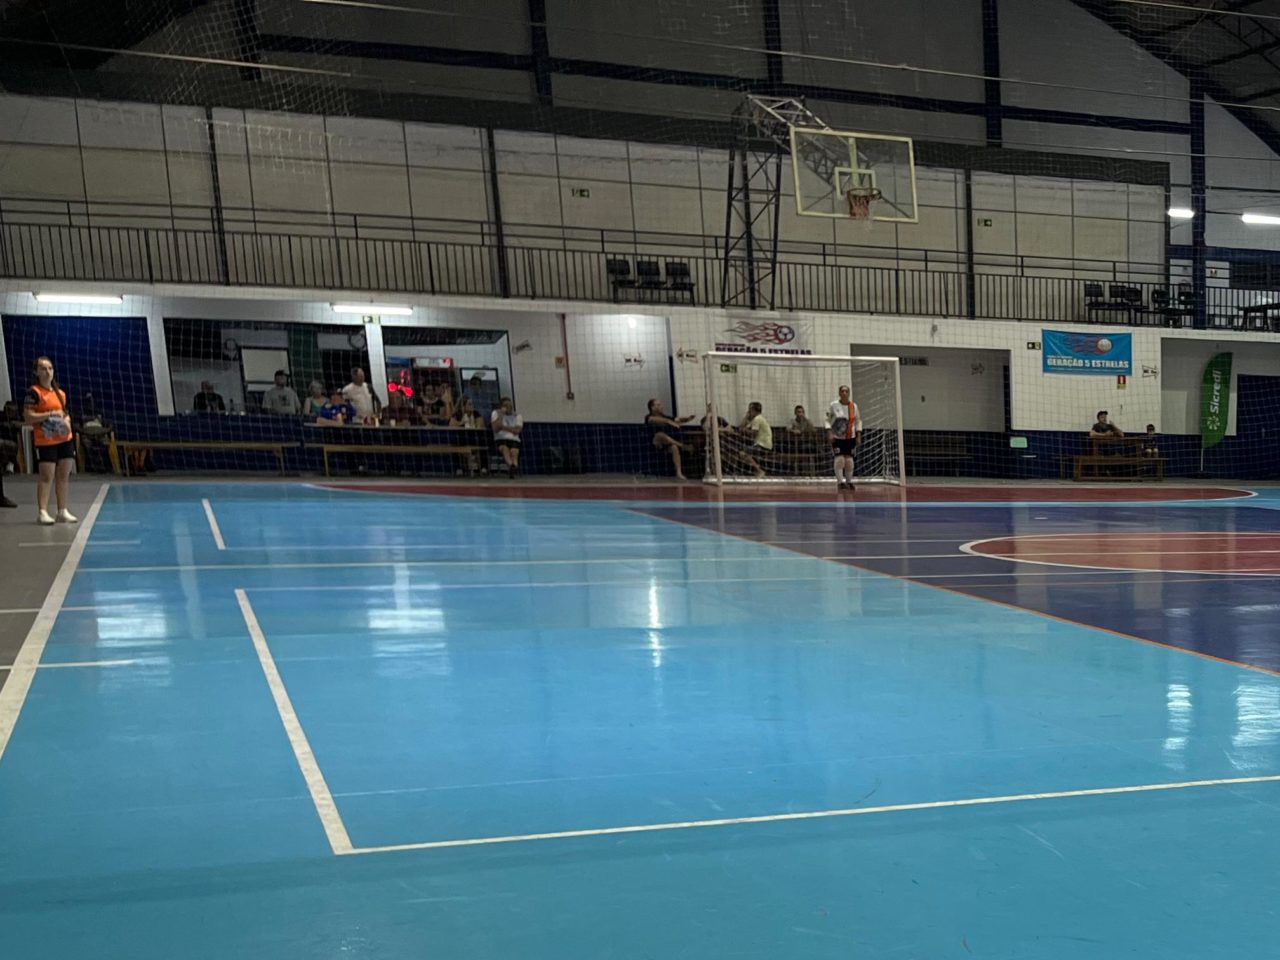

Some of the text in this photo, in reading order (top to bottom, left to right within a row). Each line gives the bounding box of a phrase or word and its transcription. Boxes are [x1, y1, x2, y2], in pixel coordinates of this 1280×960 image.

[1047, 357, 1129, 368] GERAÇÃO 5 ESTRELAS
[1210, 368, 1222, 413] Sicredi
